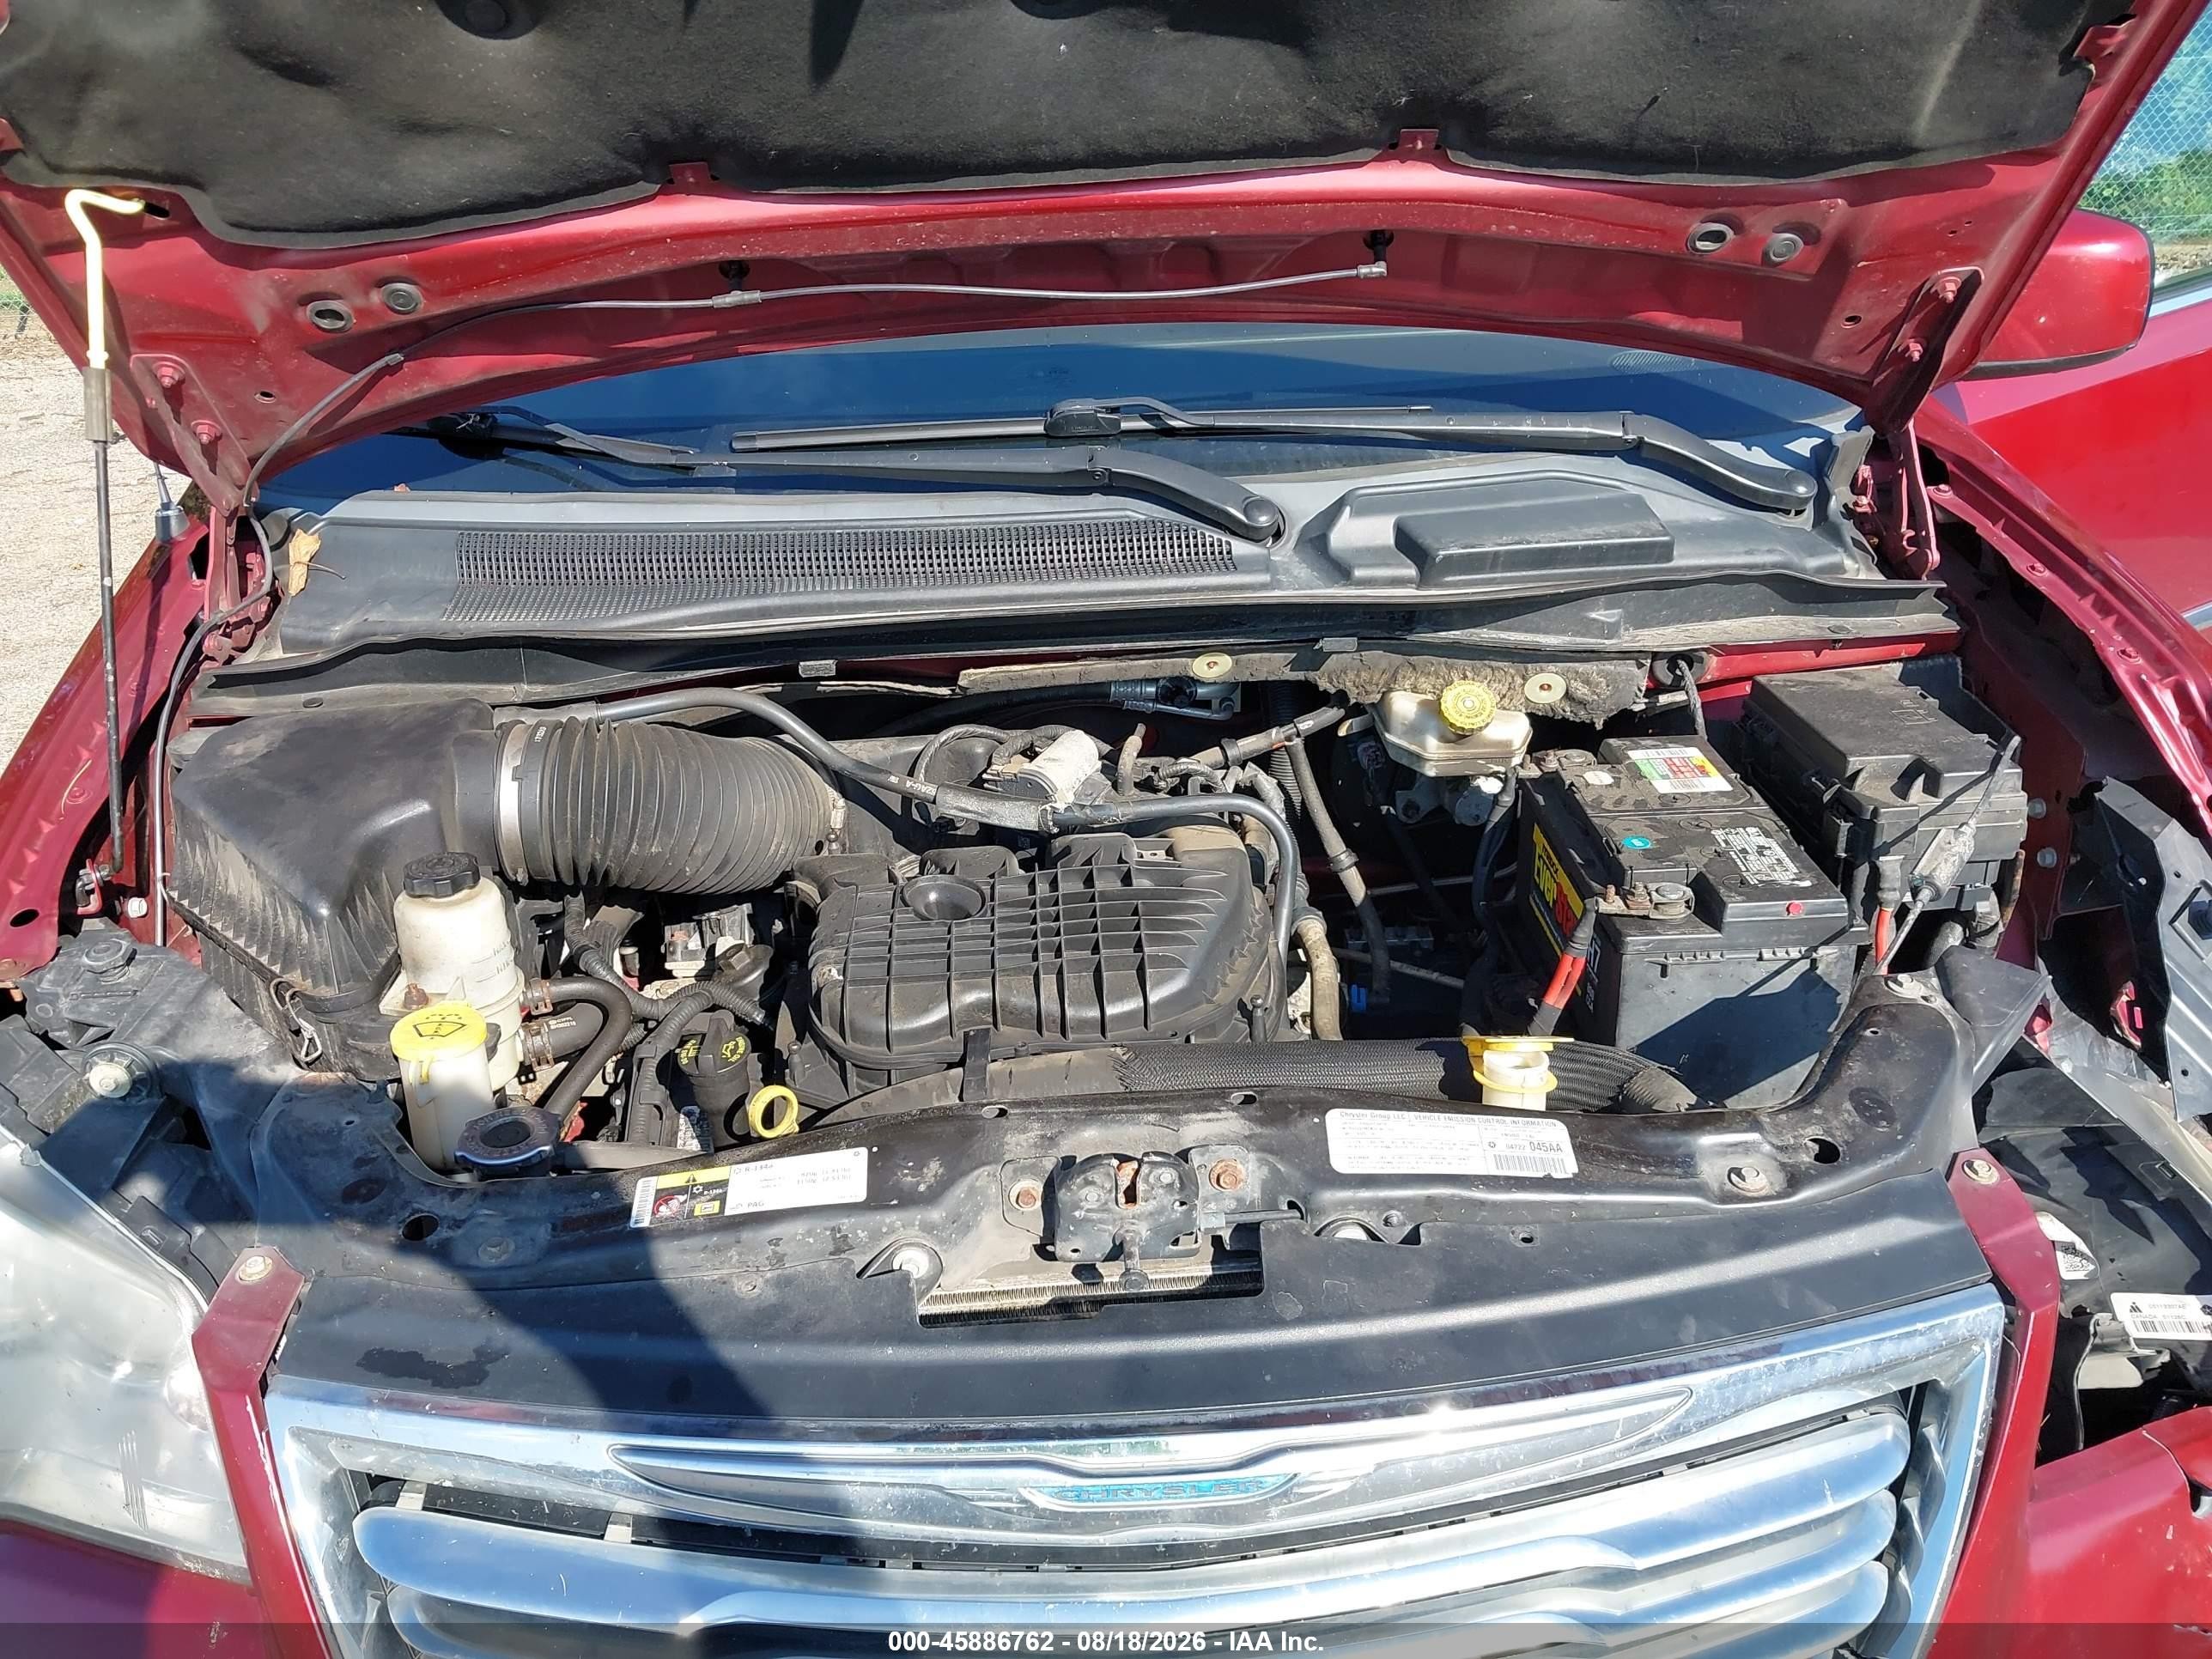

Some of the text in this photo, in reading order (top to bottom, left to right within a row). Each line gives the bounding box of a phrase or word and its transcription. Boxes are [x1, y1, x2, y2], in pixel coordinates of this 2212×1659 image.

[1443, 1115, 1476, 1124] EMISSION
[1477, 1117, 1508, 1126] CONTROL
[1510, 1119, 1557, 1127] INFORMATION
[1528, 1141, 1563, 1153] 045AA
[1052, 1479, 1266, 1499] CHRYSLER
